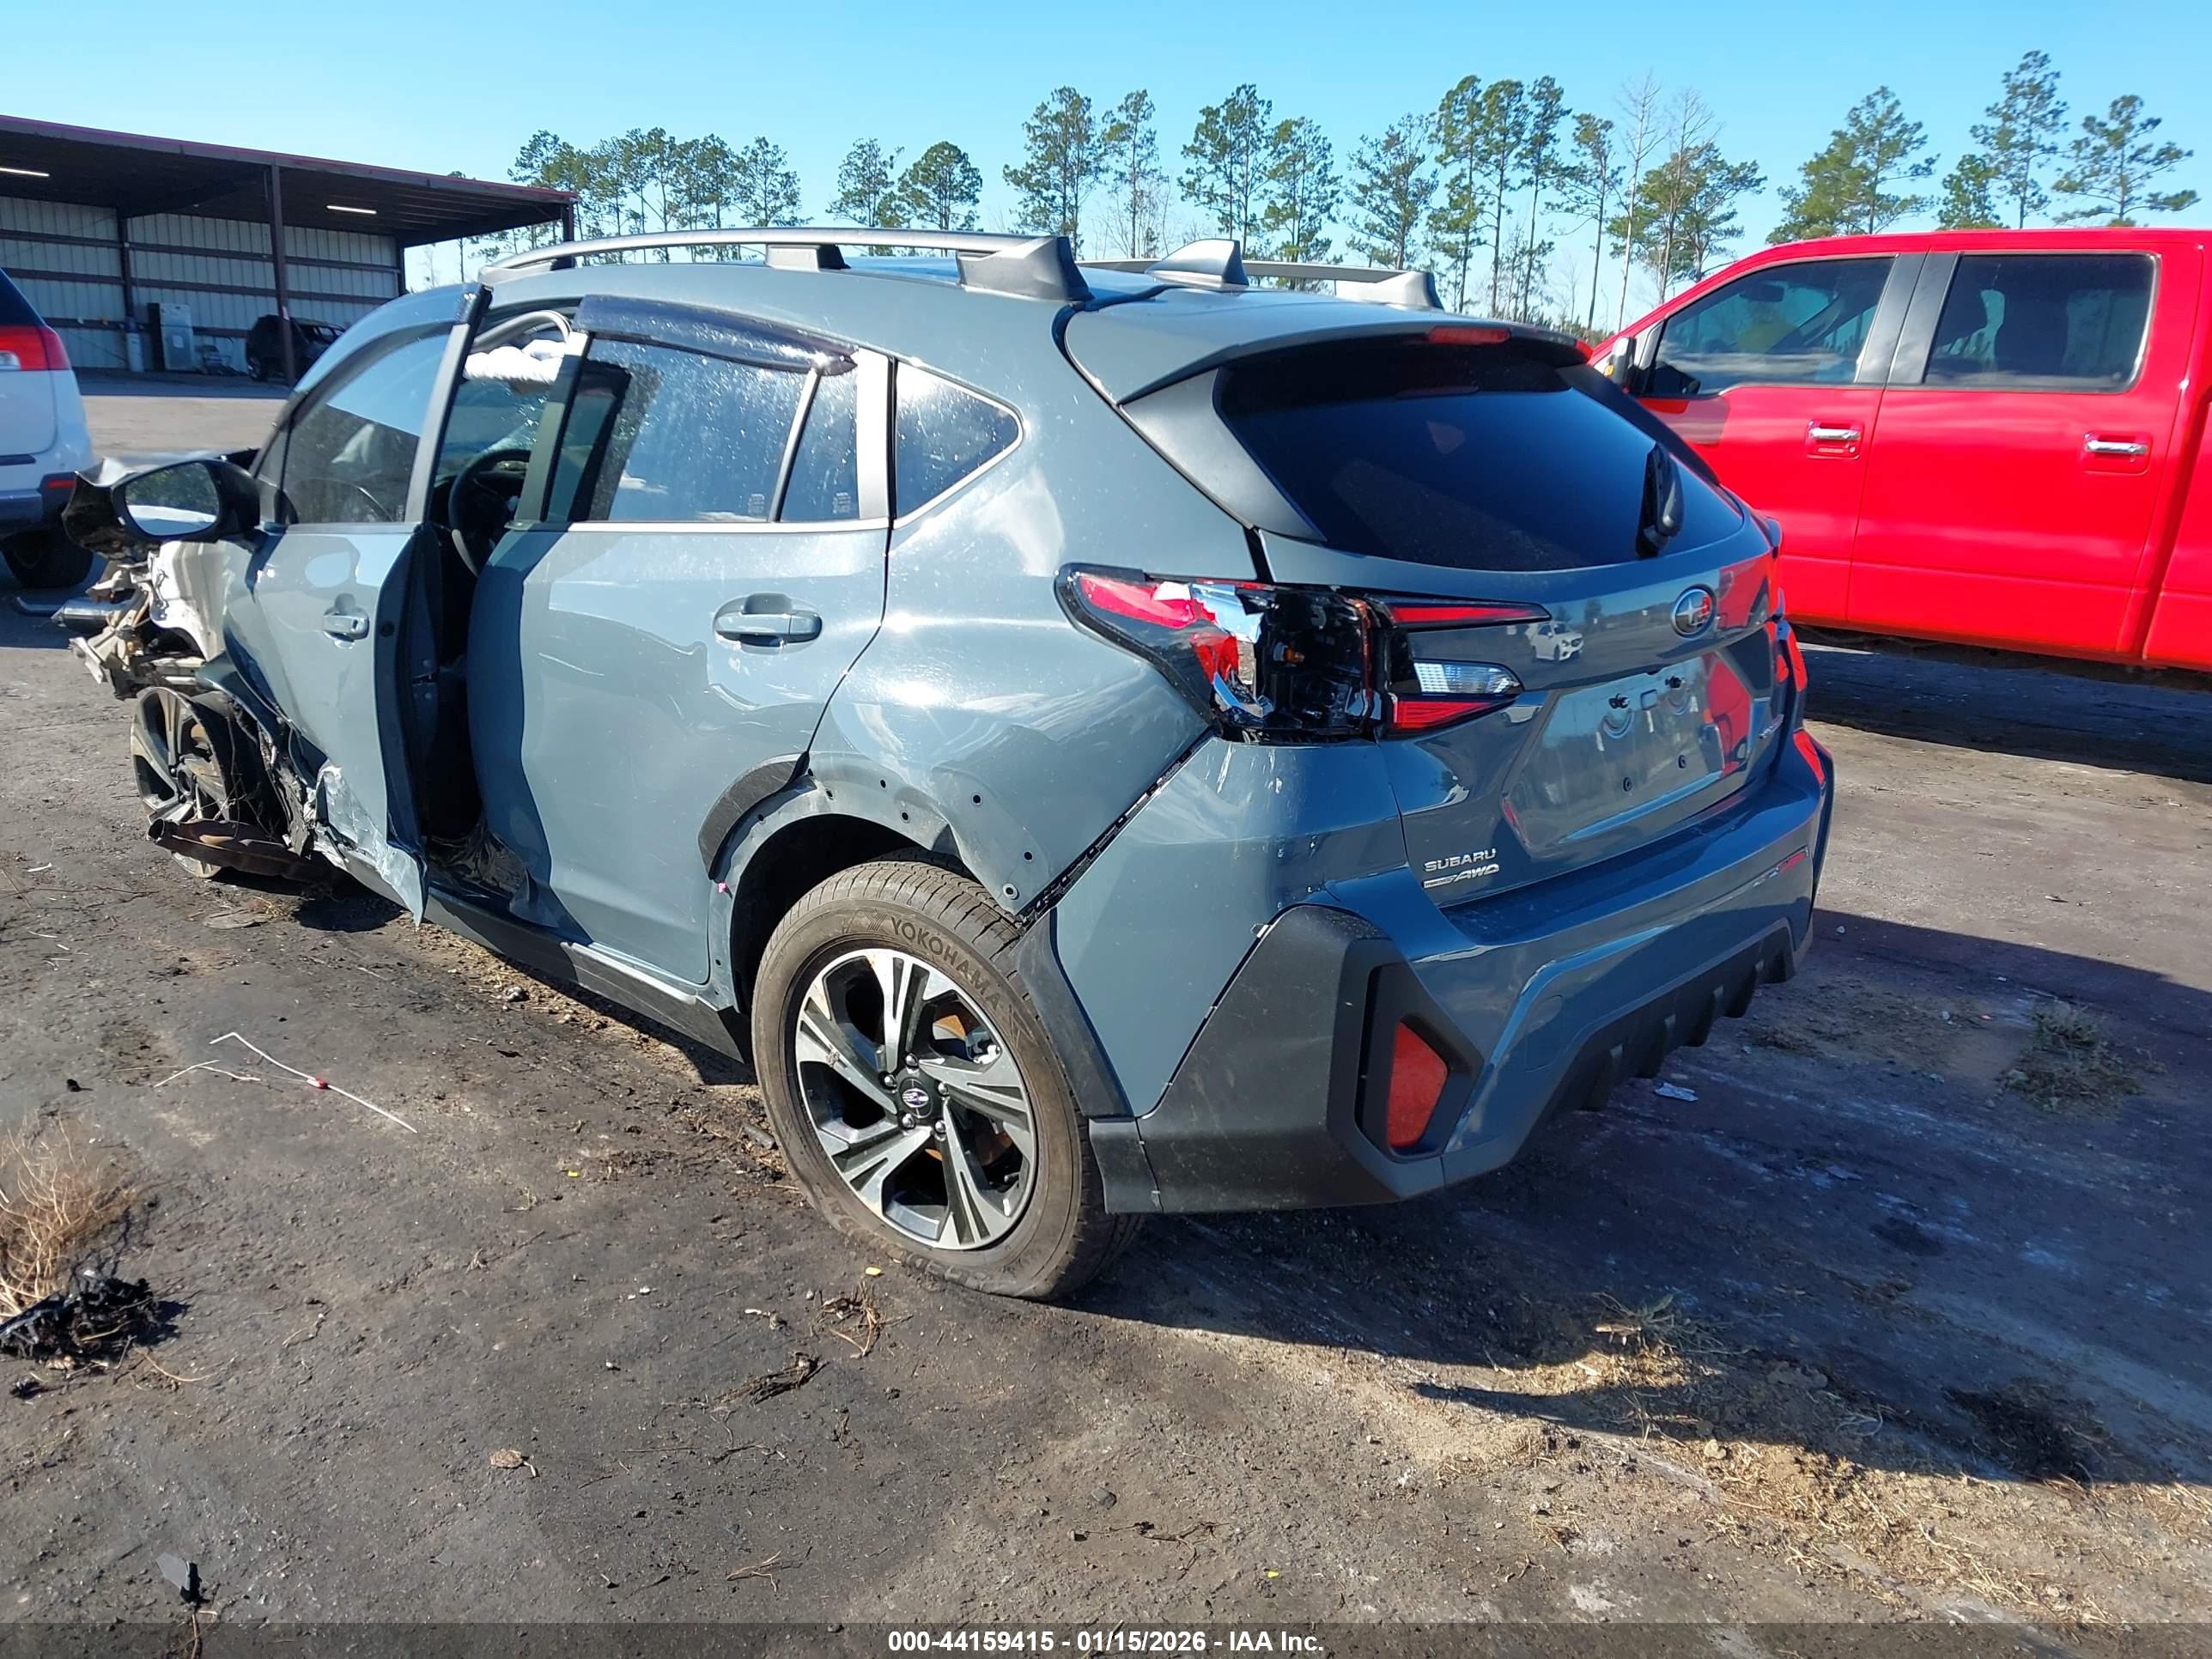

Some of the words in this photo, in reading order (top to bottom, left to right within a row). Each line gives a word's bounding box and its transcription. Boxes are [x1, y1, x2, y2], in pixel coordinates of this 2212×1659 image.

[1425, 848, 1497, 872] SUBARU
[1454, 863, 1500, 883] AWD
[891, 916, 1001, 1011] YOKOHAMA
